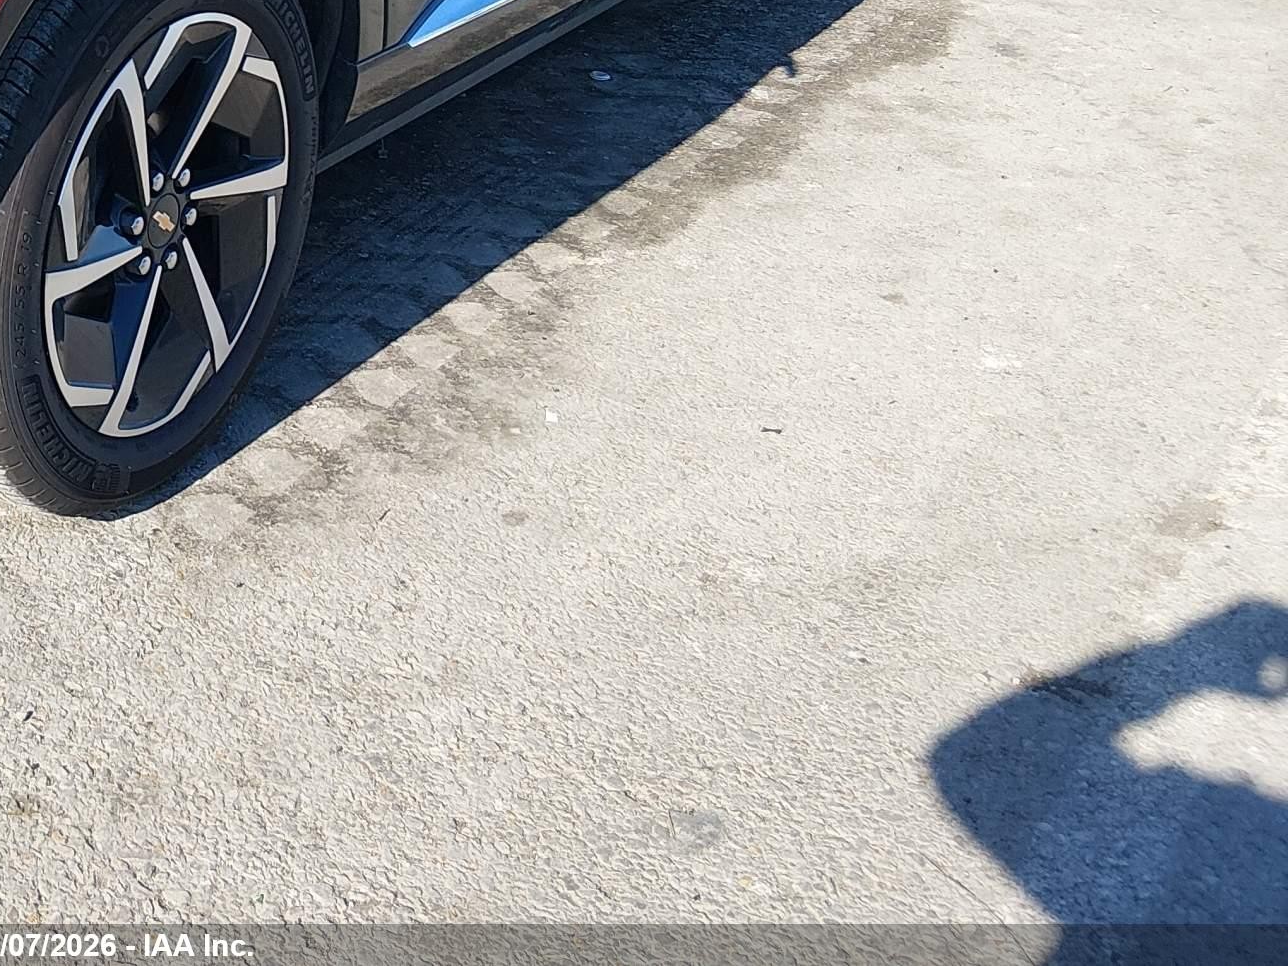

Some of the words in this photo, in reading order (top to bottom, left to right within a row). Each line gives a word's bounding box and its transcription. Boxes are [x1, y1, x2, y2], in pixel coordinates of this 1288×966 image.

[21, 232, 32, 251] 19
[17, 263, 28, 277] R
[14, 284, 26, 358] 245/55
[22, 382, 91, 483] MICHELIN
